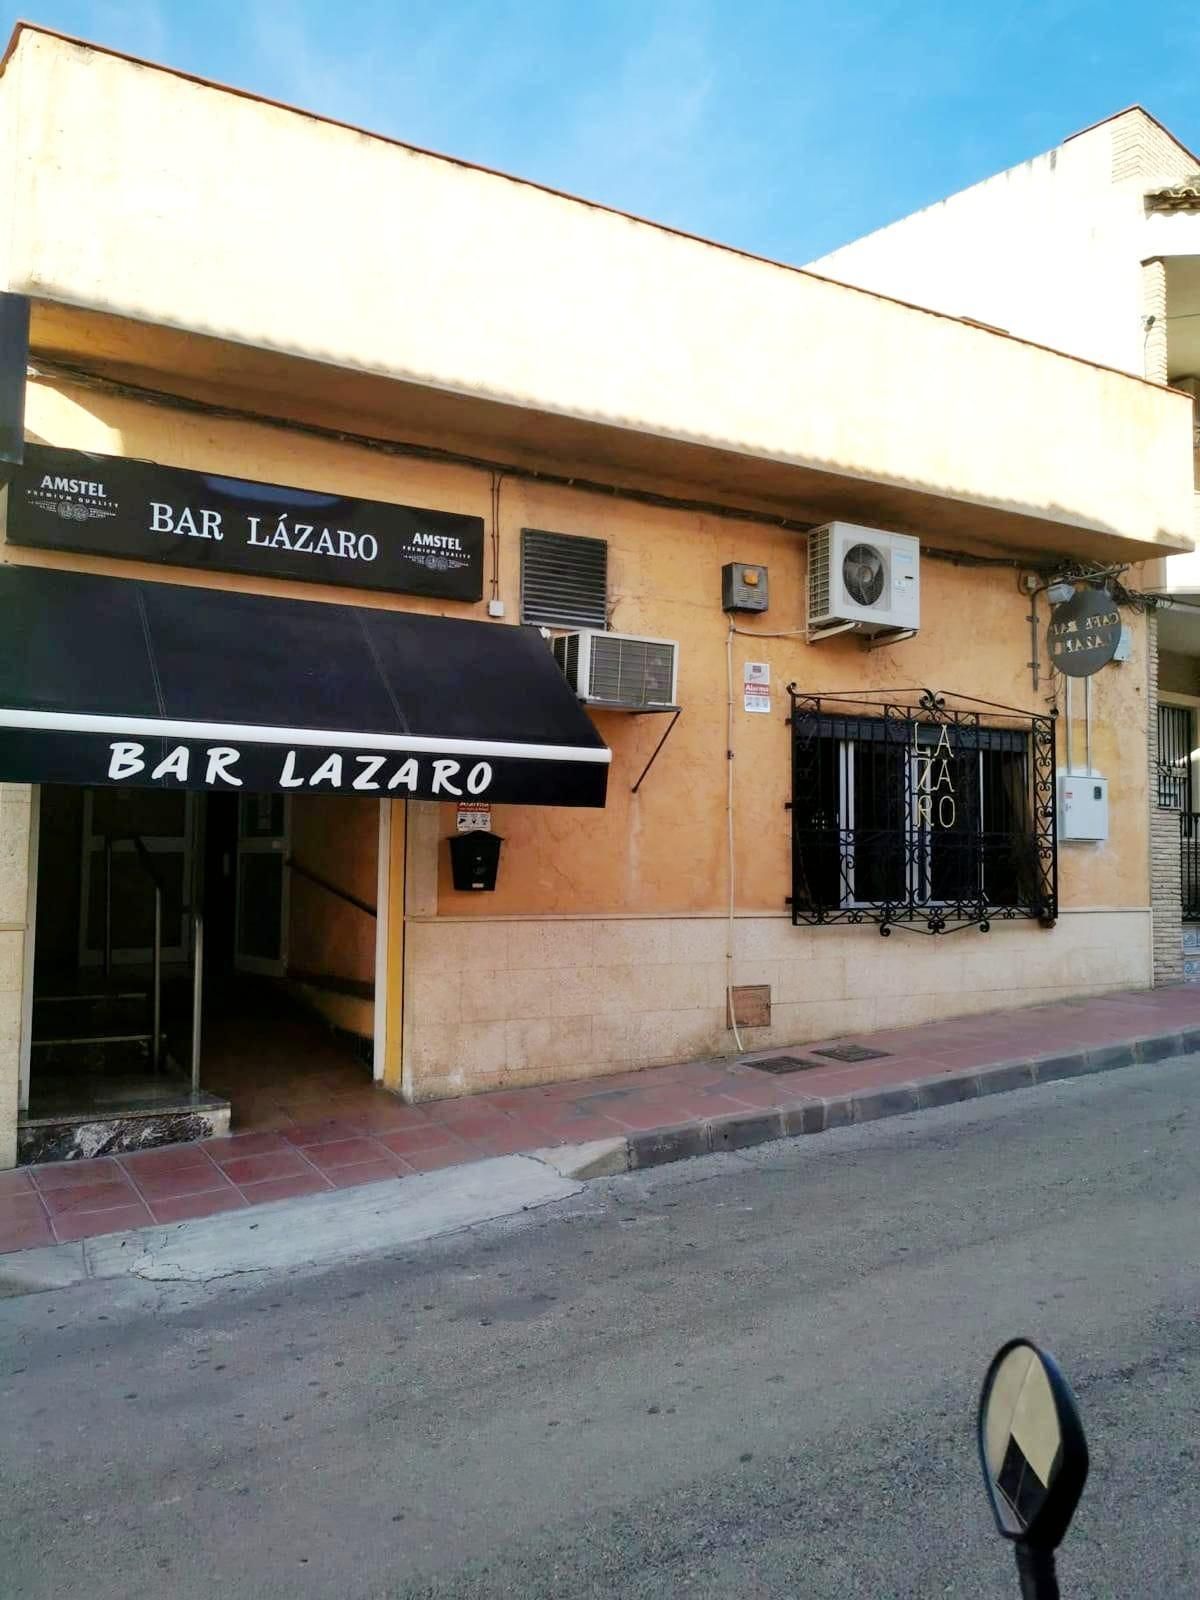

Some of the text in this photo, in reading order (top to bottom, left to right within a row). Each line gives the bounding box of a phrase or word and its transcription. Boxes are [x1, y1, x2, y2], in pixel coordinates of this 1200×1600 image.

[40, 475, 107, 498] AMSTEL
[149, 502, 378, 562] BAR LÁZARO
[412, 532, 462, 551] AMSTEL
[107, 742, 494, 796] BAR LAZARO
